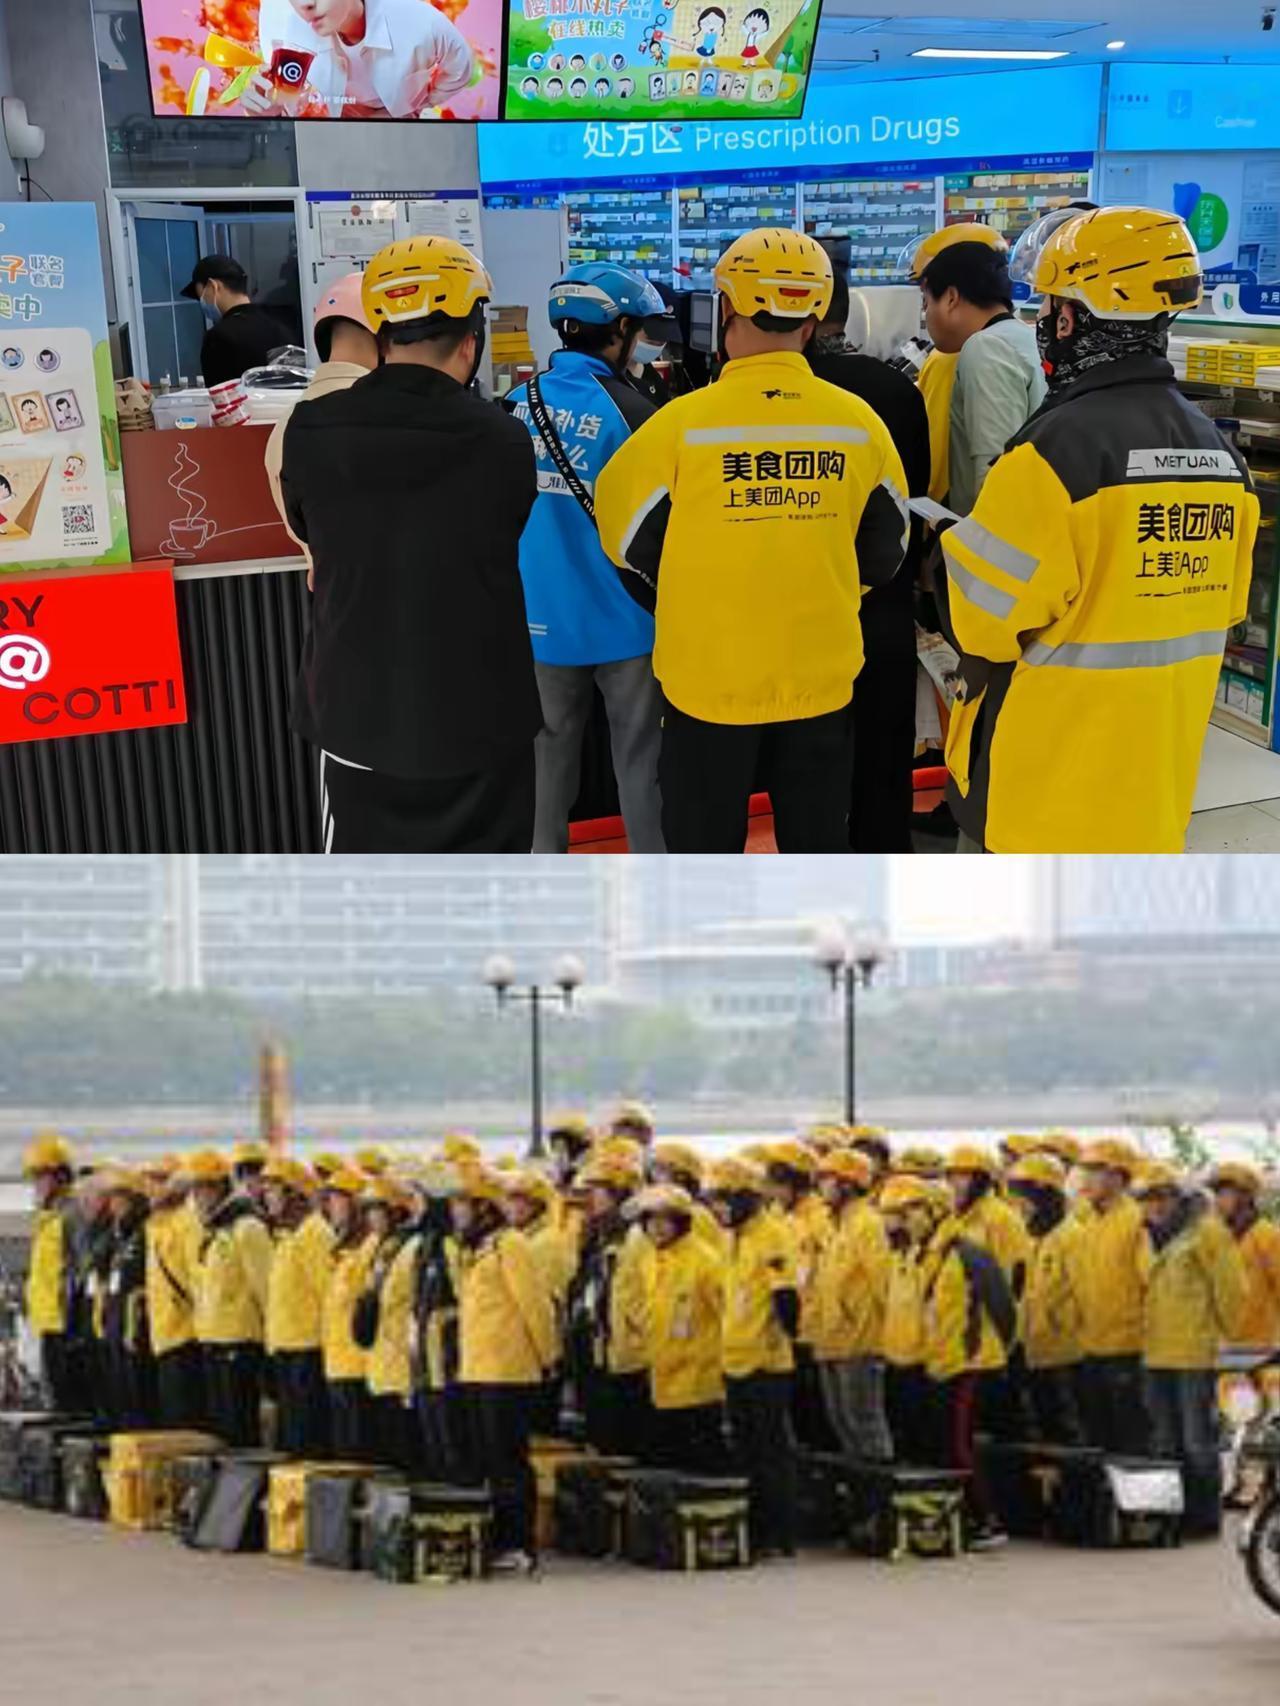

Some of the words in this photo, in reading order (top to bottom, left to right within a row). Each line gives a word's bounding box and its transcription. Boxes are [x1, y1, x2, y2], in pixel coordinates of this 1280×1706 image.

[550, 20, 625, 39] 在线热卖
[583, 121, 682, 158] 处方区
[695, 122, 860, 152] Prescription
[871, 115, 961, 145] Drugs
[29, 254, 63, 272] 联名
[722, 450, 846, 483] 美食团购
[723, 486, 821, 509] 上美团App
[1137, 502, 1235, 544] 美食团购
[23, 679, 176, 724] COTTI
